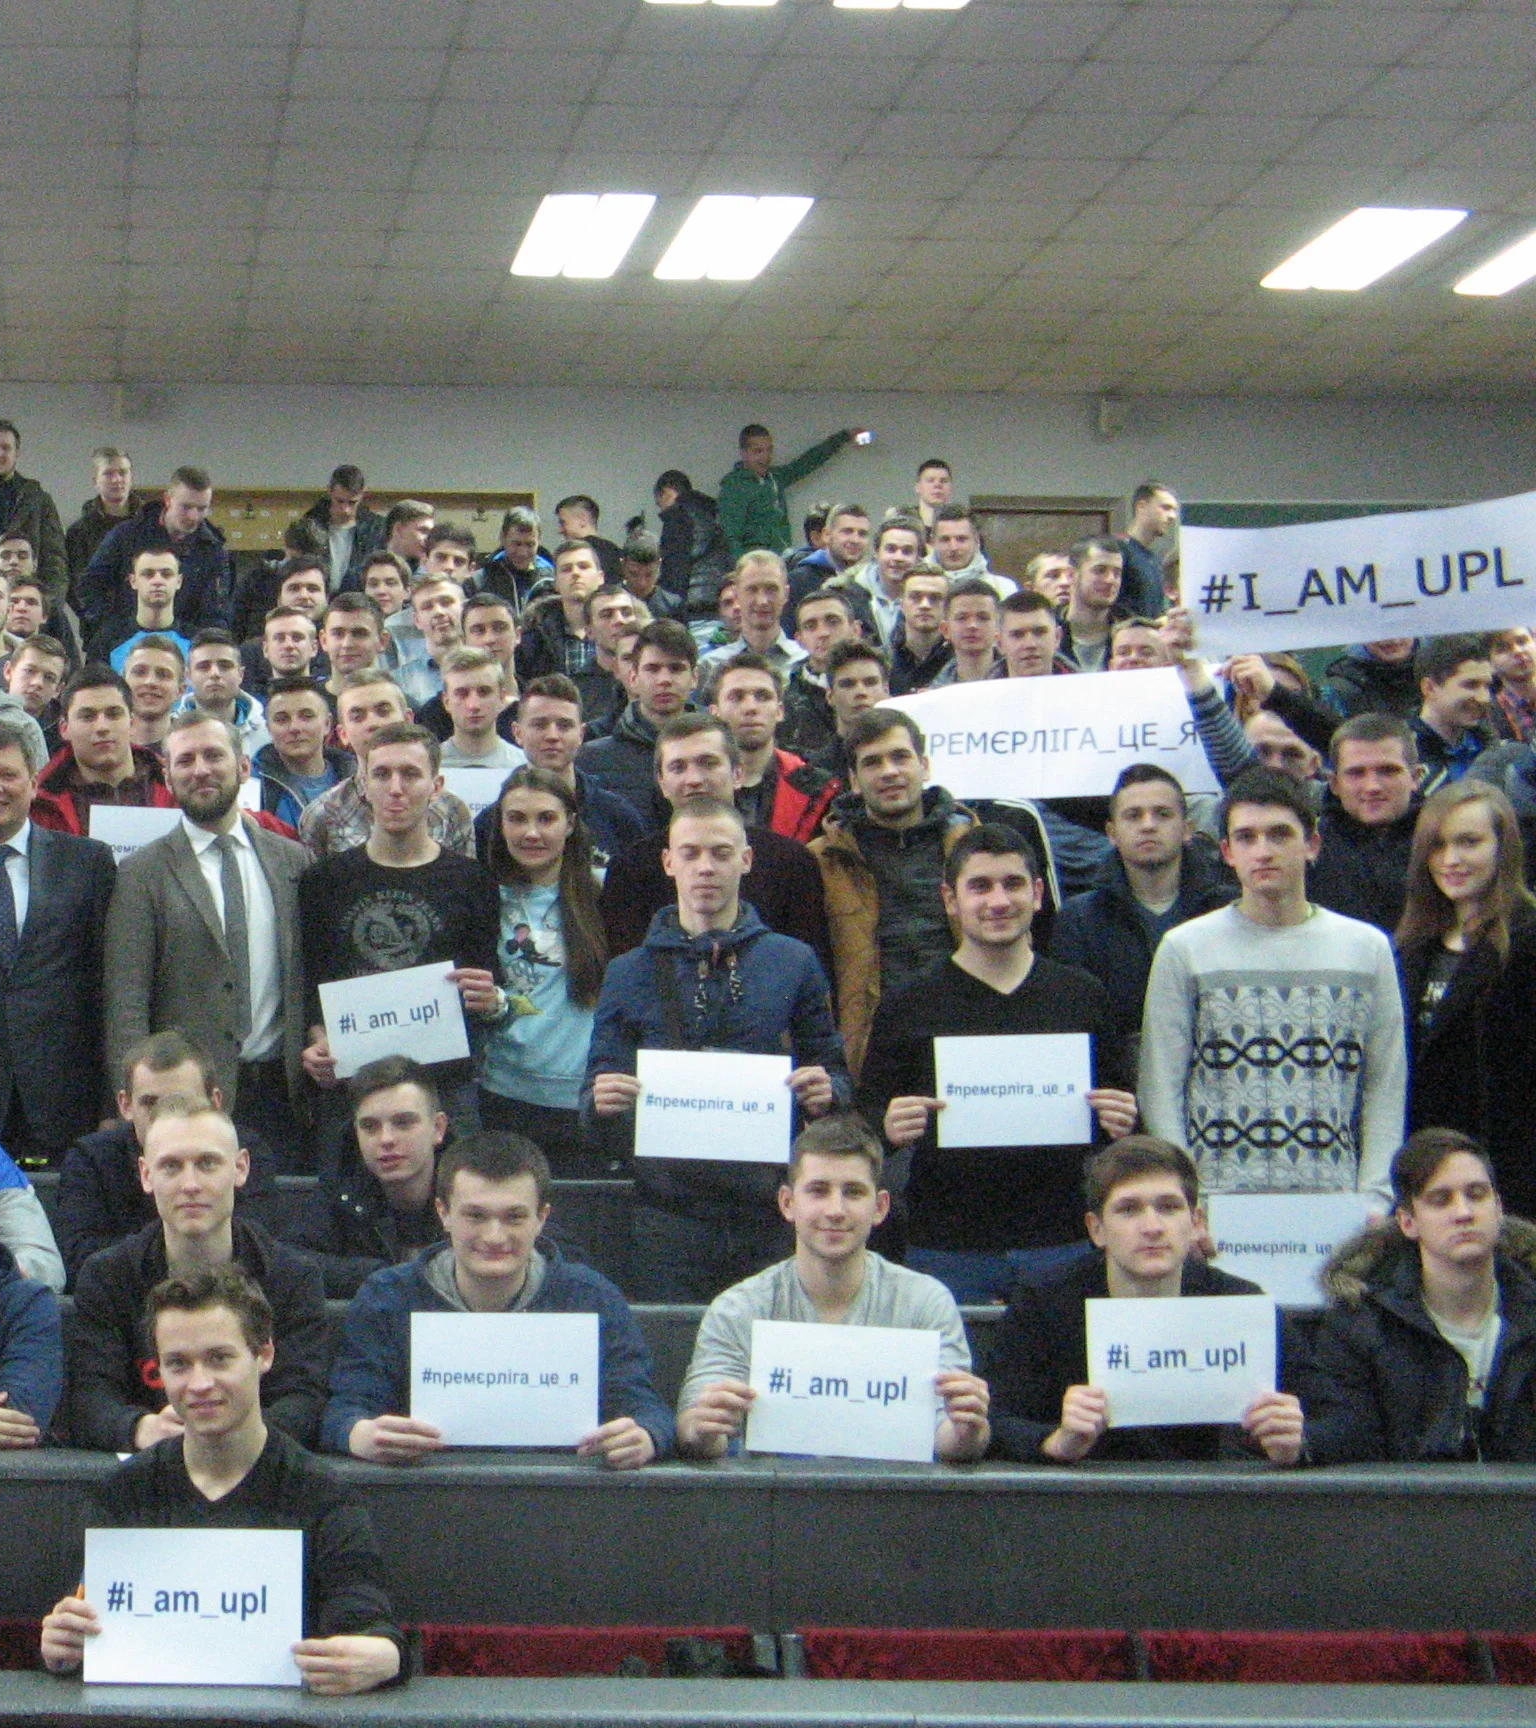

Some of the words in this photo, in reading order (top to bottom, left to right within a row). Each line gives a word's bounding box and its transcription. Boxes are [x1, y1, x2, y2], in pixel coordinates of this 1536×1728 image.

[1198, 547, 1525, 616] #I_AM_UPL
[339, 998, 441, 1035] #i_am_upl
[1217, 1240, 1332, 1257] #премєрліга_це
[1107, 1341, 1246, 1373] #i_am_upl
[769, 1367, 908, 1406] #i_am_upl
[107, 1581, 267, 1622] #i_am_upl
